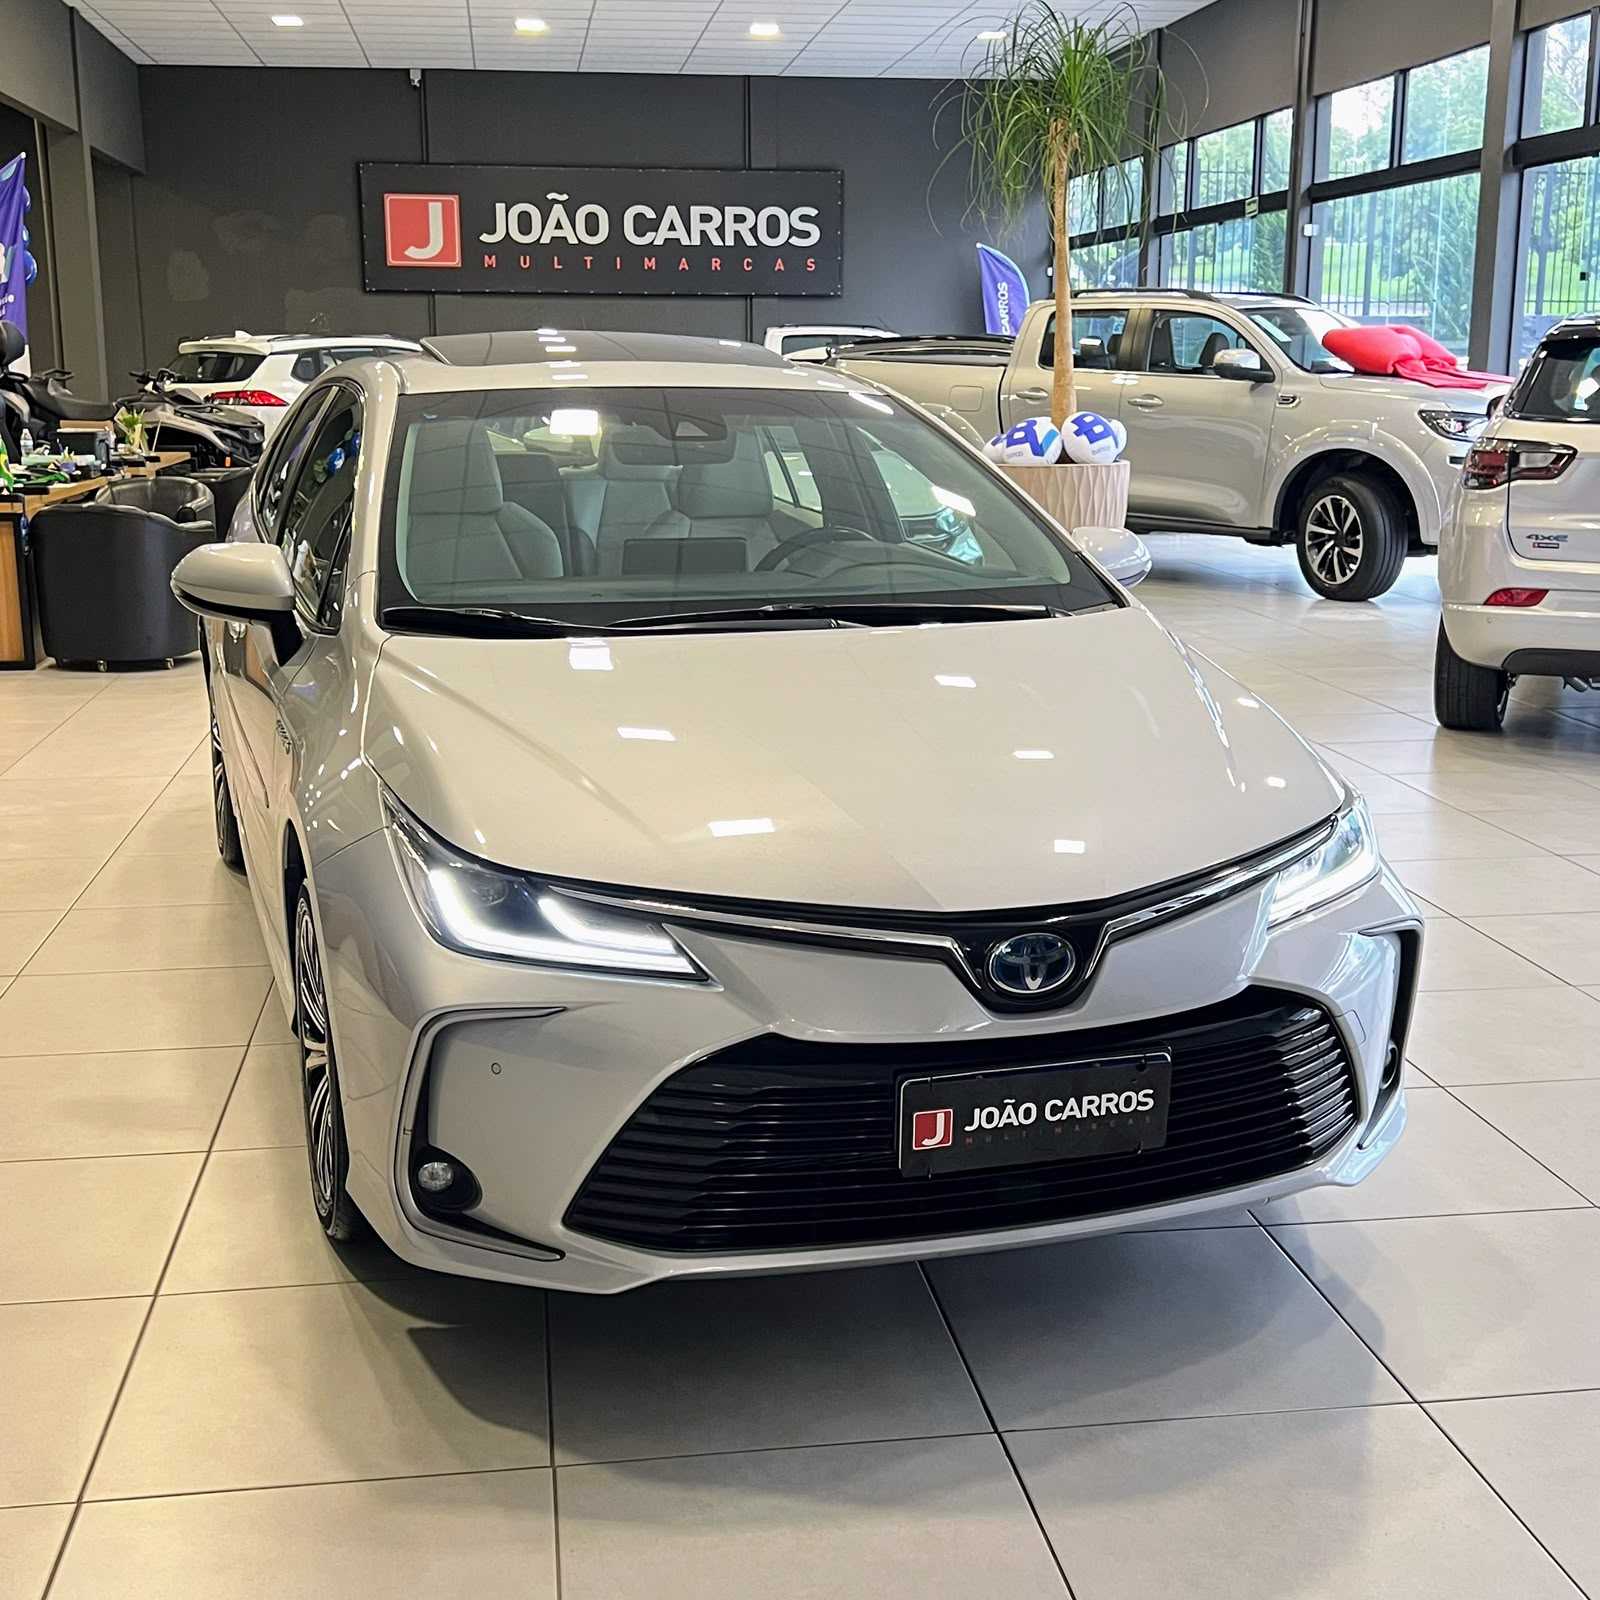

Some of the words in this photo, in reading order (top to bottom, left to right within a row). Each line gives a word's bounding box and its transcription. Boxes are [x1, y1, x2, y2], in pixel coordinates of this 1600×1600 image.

[404, 201, 444, 260] J
[479, 192, 610, 245] JOÃO
[623, 204, 822, 248] CARROS
[483, 255, 817, 272] MULTIMARCAS
[921, 1112, 945, 1146] J
[964, 1098, 1038, 1132] JOÃO
[1044, 1088, 1154, 1122] CARROS
